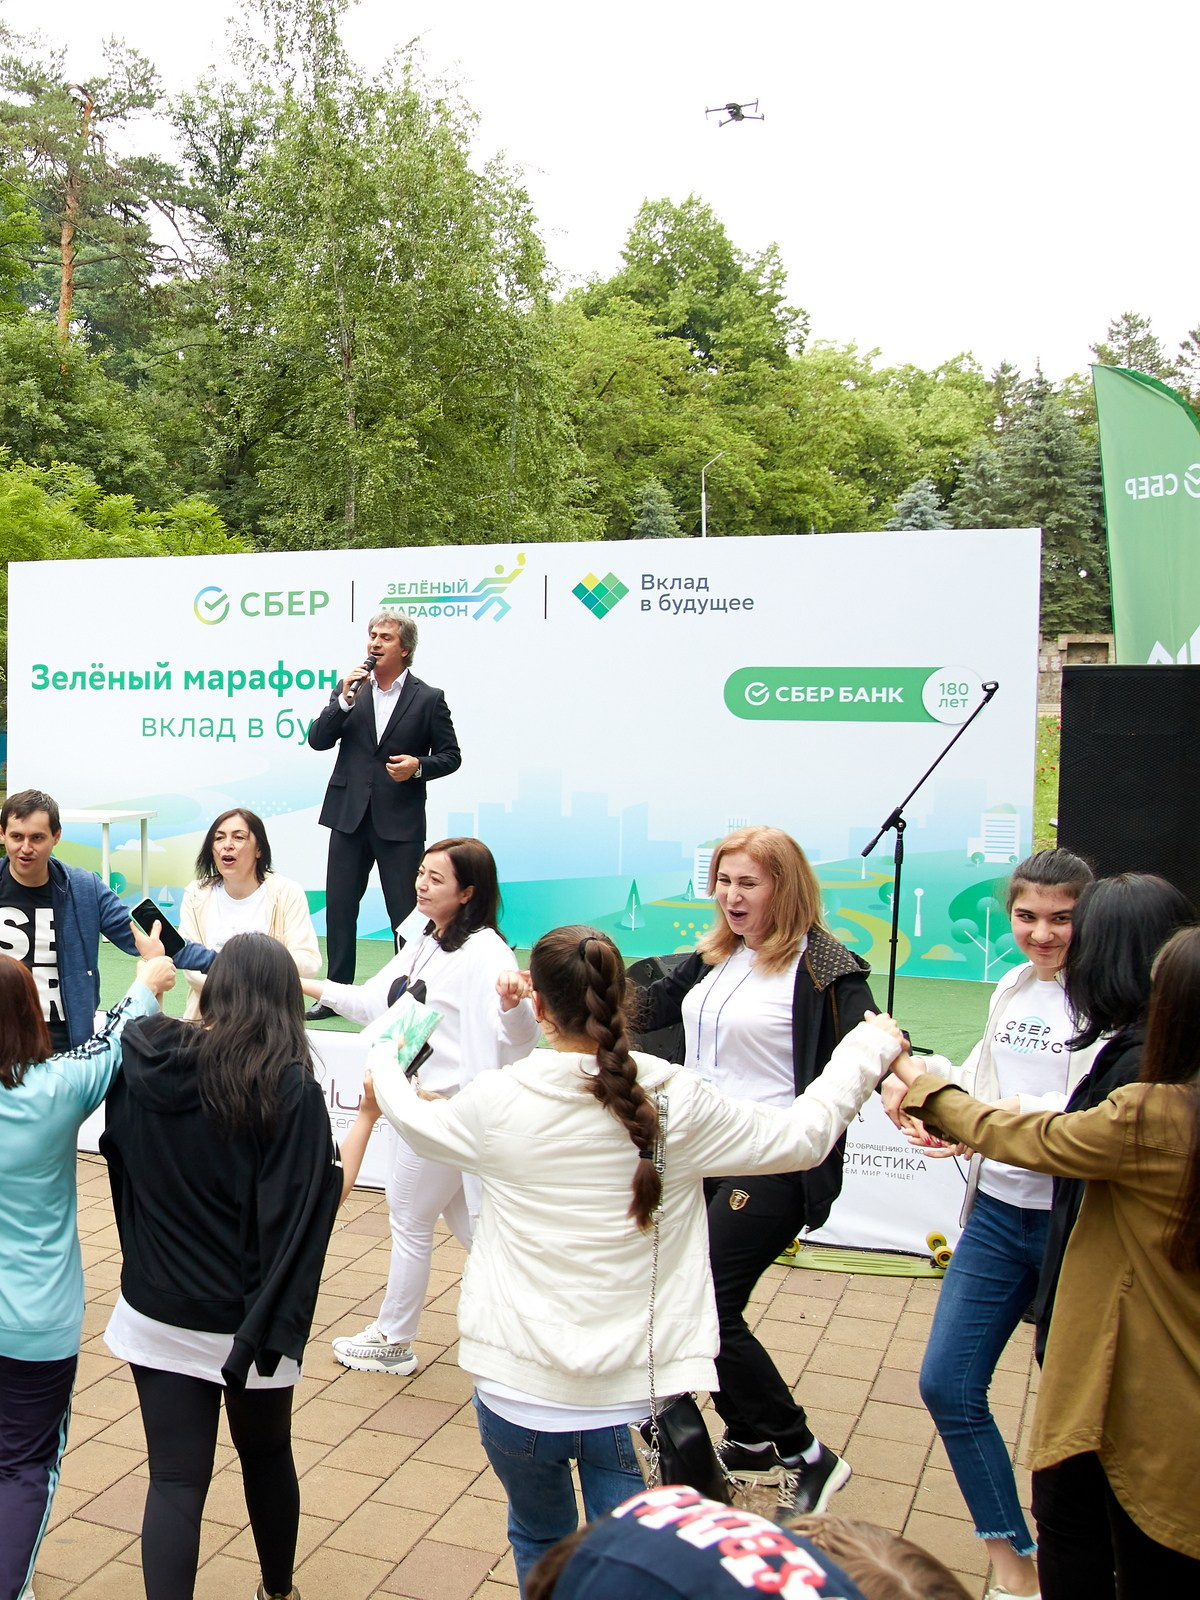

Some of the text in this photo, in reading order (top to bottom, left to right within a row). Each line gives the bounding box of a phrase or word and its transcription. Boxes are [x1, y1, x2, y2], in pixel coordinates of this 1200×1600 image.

[387, 578, 468, 595] ЗЕЛЁНЫЙ
[641, 574, 710, 592] Вклад
[240, 589, 330, 617] СБЕР
[382, 604, 468, 618] АРАФОН
[640, 594, 755, 615] в будущее
[31, 660, 338, 698] Зелёный марафон
[775, 686, 904, 703] СБЕР БАНК
[938, 682, 969, 696] 180
[938, 697, 969, 708] лет
[142, 708, 315, 746] вклад в бу
[855, 1142, 903, 1153] ОБРАЩЕНИЮ
[843, 1152, 927, 1171] ОГИСТИКА
[843, 1167, 858, 1175] ЕМ
[861, 1169, 881, 1177] МИР
